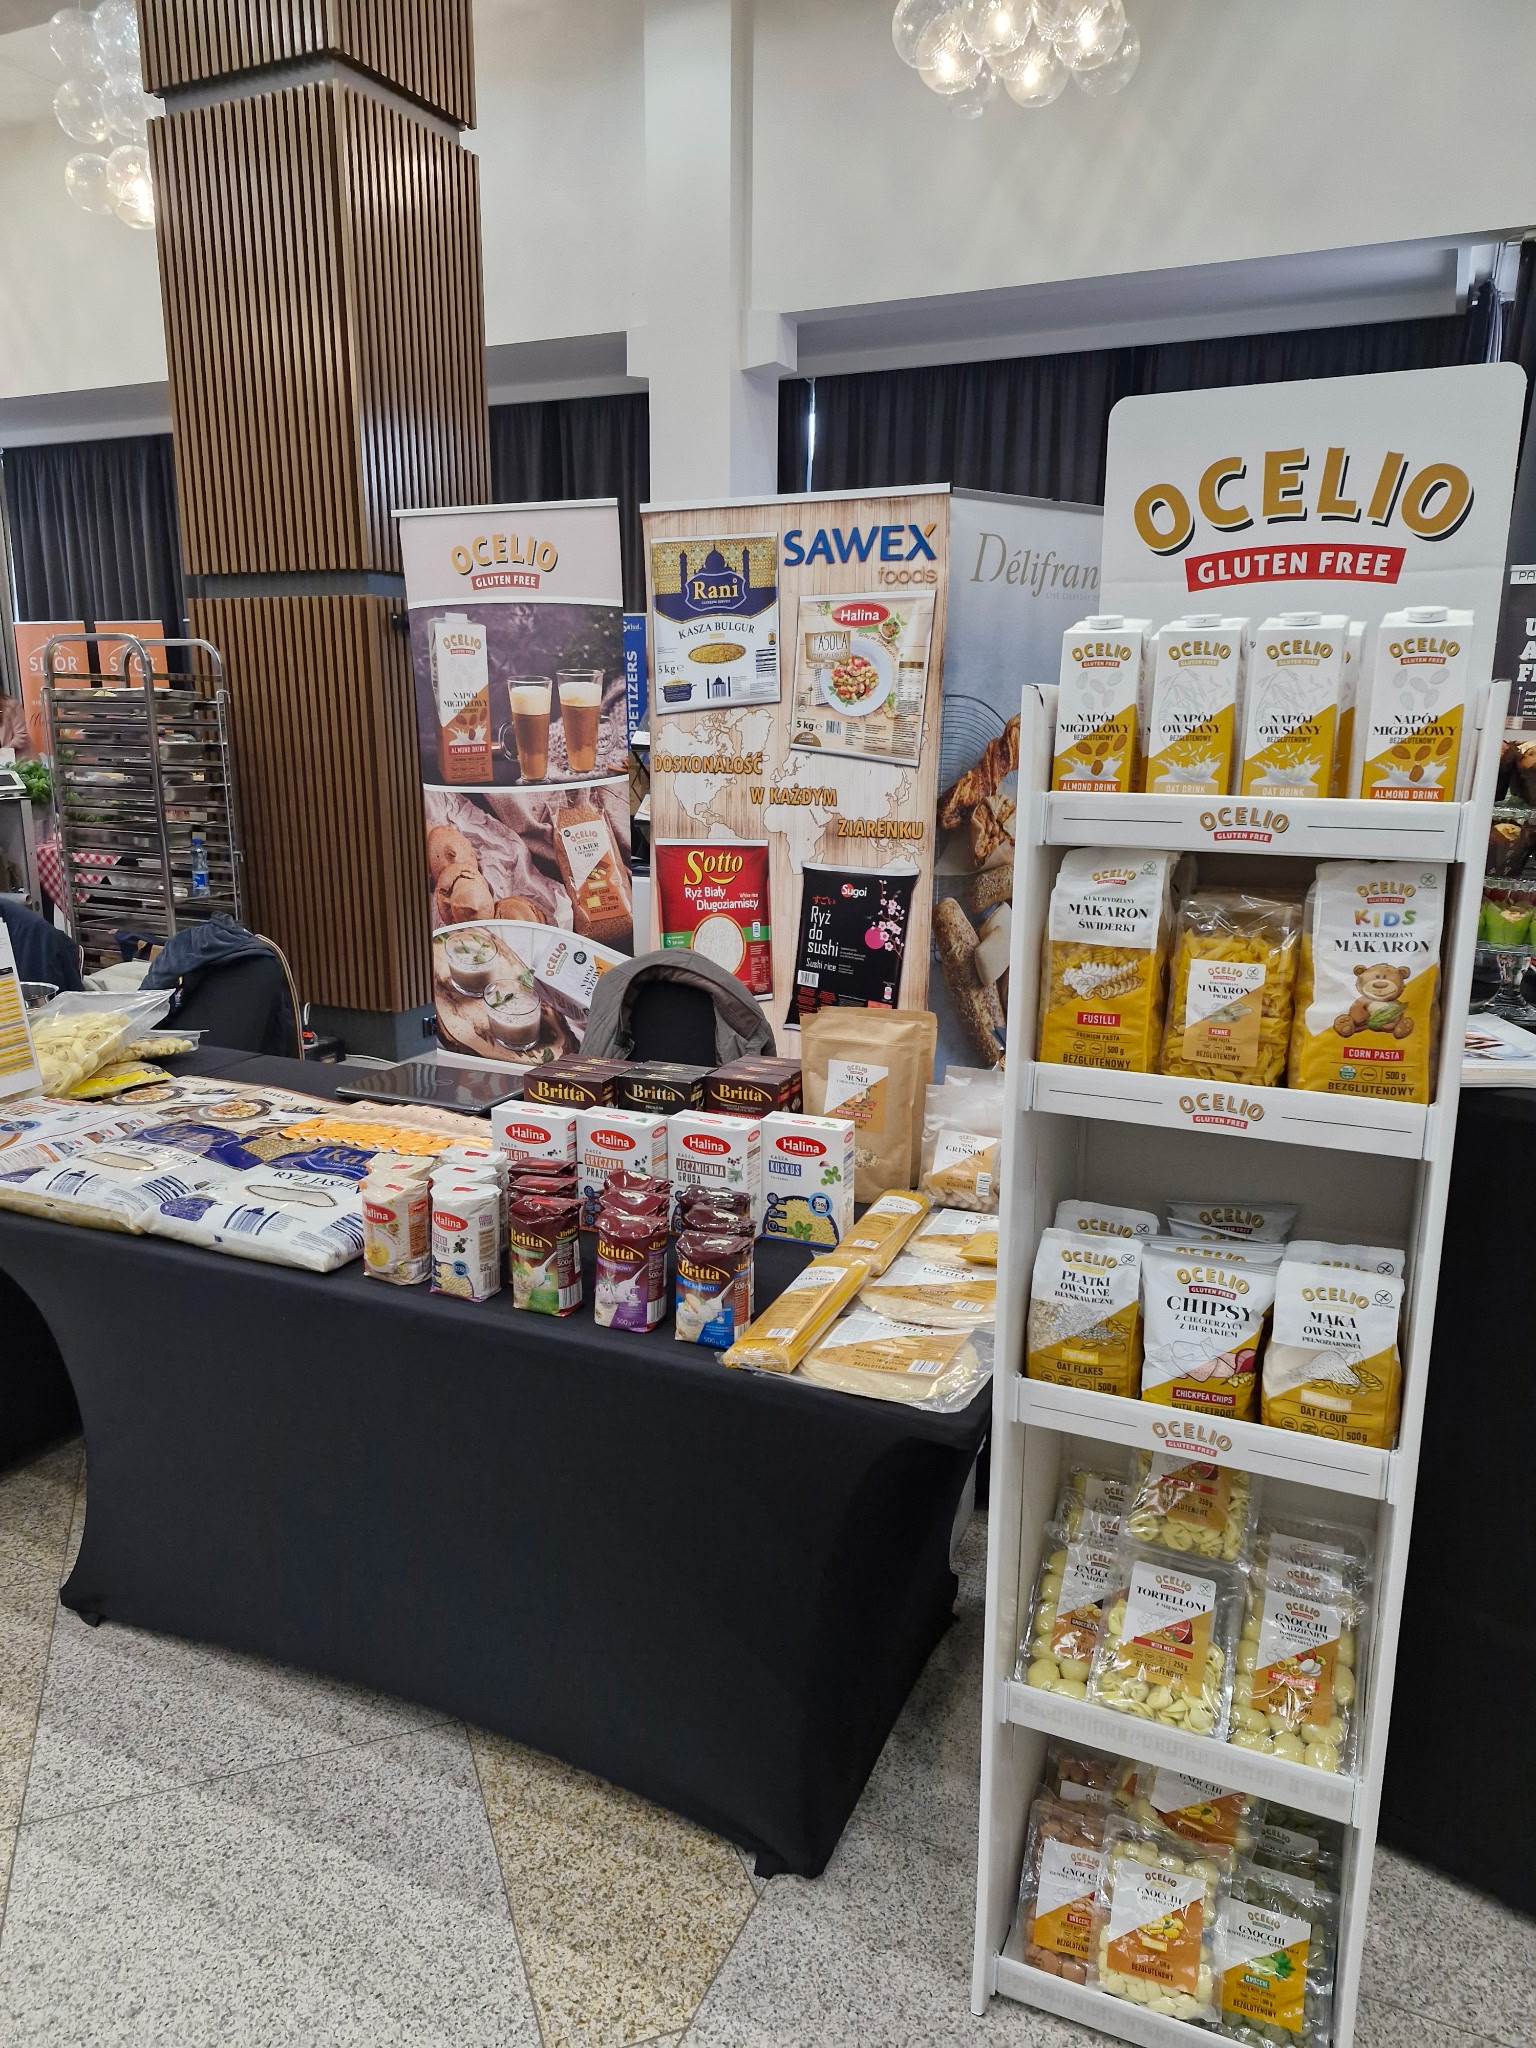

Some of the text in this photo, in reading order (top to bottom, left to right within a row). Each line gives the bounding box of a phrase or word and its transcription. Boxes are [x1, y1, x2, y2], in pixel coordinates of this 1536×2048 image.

[1133, 447, 1474, 556] OCELIO
[783, 523, 937, 567] SAWEX
[451, 533, 558, 575] OCELIO
[970, 532, 1099, 597] Délifran
[1197, 551, 1393, 584] GLUTEN FREE
[475, 574, 537, 587] GLUTEN FREE
[878, 566, 938, 585] foods
[693, 578, 739, 600] Rani
[840, 609, 880, 622] Halina
[678, 621, 755, 640] KASZA BULGUR
[443, 634, 481, 650] OCELIO
[813, 633, 848, 651] FASOLA
[1267, 640, 1333, 659] OCELIO
[1389, 638, 1460, 657] OCELIO
[1071, 643, 1132, 661] OCELIO
[1169, 641, 1231, 660] OCELIO
[29, 657, 78, 672] SIOR
[658, 663, 676, 674] 5 kg
[1077, 712, 1115, 722] NAPÓJ
[1173, 711, 1214, 722] NAPÓJ
[1270, 713, 1313, 724] NAPÓJ
[1393, 713, 1439, 724] NAPÓJ
[804, 720, 814, 731] kg
[1060, 724, 1129, 733] MIGDAŁOWY
[1162, 724, 1221, 734] OWSIANY
[1259, 726, 1322, 735] OWSIANY
[1373, 726, 1457, 735] MIGDAŁOWY
[654, 752, 763, 774] DOSKONAŁOŚĆ
[1062, 782, 1117, 791] ALMOND DRINK
[1166, 785, 1205, 793] OAT DRINK
[1262, 787, 1304, 797] OAT DRINK
[750, 783, 838, 806] W KAŻDYM
[1374, 790, 1439, 799] ALMOND DRINK
[1199, 806, 1290, 833] OCELIO
[570, 830, 598, 842] OCELIO
[837, 818, 923, 840] ZIARENKU
[1216, 832, 1270, 842] GLUTEN FREE
[683, 850, 743, 886] Sotto
[1091, 869, 1137, 883] OCELIO
[685, 886, 726, 900] Ryż Biały
[841, 884, 867, 898] Sugoi
[1357, 882, 1416, 897] OCELIO
[696, 899, 758, 912] Długoziarnisty
[1068, 903, 1149, 918] MAKARON
[810, 906, 831, 927] Ryż
[1354, 909, 1416, 928] KIDS
[809, 923, 822, 940] do
[1077, 918, 1136, 932] ŚWIDERKI
[808, 939, 839, 957] sushi
[1334, 940, 1432, 953] MAKARON
[546, 943, 567, 976] OCELIO
[806, 958, 836, 971] Sushi rice
[1208, 967, 1242, 977] OCELIO
[1198, 984, 1250, 995] MAKARON
[1082, 1014, 1116, 1024] FUSILLI
[1076, 1032, 1100, 1040] PREMIUM
[1063, 1054, 1130, 1069] BEZGLUTENOWY
[1196, 1051, 1240, 1061] BEZGLUTENOWY
[1348, 1048, 1401, 1060] CORN PASTA
[847, 1065, 867, 1073] OCELIO
[1385, 1070, 1399, 1080] 500
[846, 1074, 868, 1083] MUSLI
[537, 1081, 585, 1102] Britta
[632, 1084, 676, 1102] Britta
[719, 1083, 762, 1103] Britta
[1328, 1081, 1415, 1096] BEZGLUTENOWY
[1178, 1092, 1265, 1121] OCELIO
[1195, 1115, 1246, 1128] GLUTEN FREE
[512, 1127, 545, 1141] Halina
[597, 1133, 630, 1147] Halina
[689, 1137, 725, 1152] Halina
[783, 1139, 820, 1154] Halina
[946, 1145, 985, 1156] GRISSINI
[586, 1155, 622, 1169] GRYCZANA
[677, 1161, 725, 1177] JĘCZMIENNA
[770, 1162, 800, 1176] KUSKUS
[274, 1171, 306, 1182] RYŻ
[677, 1172, 701, 1185] GRUBA
[434, 1213, 462, 1229] Halina
[1199, 1208, 1264, 1228] OCELIO
[1077, 1218, 1133, 1238] OCELIO
[511, 1227, 543, 1248] Britta
[599, 1240, 634, 1260] Britta
[1061, 1250, 1118, 1269] OCELIO
[681, 1259, 720, 1280] Britta
[1061, 1270, 1111, 1287] PŁATKI
[1176, 1266, 1250, 1294] OCELIO
[1054, 1290, 1115, 1305] BŁYSKAWICZNE
[1060, 1283, 1110, 1297] OWSIANE
[1191, 1286, 1235, 1299] GLUTEN FREE
[1302, 1287, 1370, 1309] OCELIO
[1167, 1295, 1253, 1322] CHIPSY
[1183, 1315, 1244, 1331] CIECIERZYCY
[1309, 1311, 1358, 1329] MĄKA
[1188, 1324, 1239, 1338] BURAKIEM
[1303, 1325, 1361, 1342] OWSIANA
[1057, 1362, 1103, 1375] OAT FLAKES
[1175, 1389, 1233, 1403] CHICKPEA CHIPS
[1171, 1402, 1192, 1412] WITH
[1301, 1406, 1347, 1424] OAT FLOUR
[1152, 1420, 1232, 1451] OCELIO
[1167, 1440, 1216, 1457] GLUTEN FREE
[1155, 1575, 1192, 1591] OCELIO
[1137, 1586, 1206, 1612] TORTELLONI
[1286, 1602, 1320, 1617] OCELIO
[1275, 1612, 1328, 1633] GNOCCHI
[1179, 1773, 1222, 1795] GNOCCHI
[1071, 1852, 1100, 1867] OCELIO
[1145, 1872, 1177, 1888] OCELIO
[1248, 1911, 1280, 1929] OCELIO
[1239, 1925, 1285, 1945] GNOCCHI
[1233, 1999, 1276, 2018] BEZGLUTENOWY
